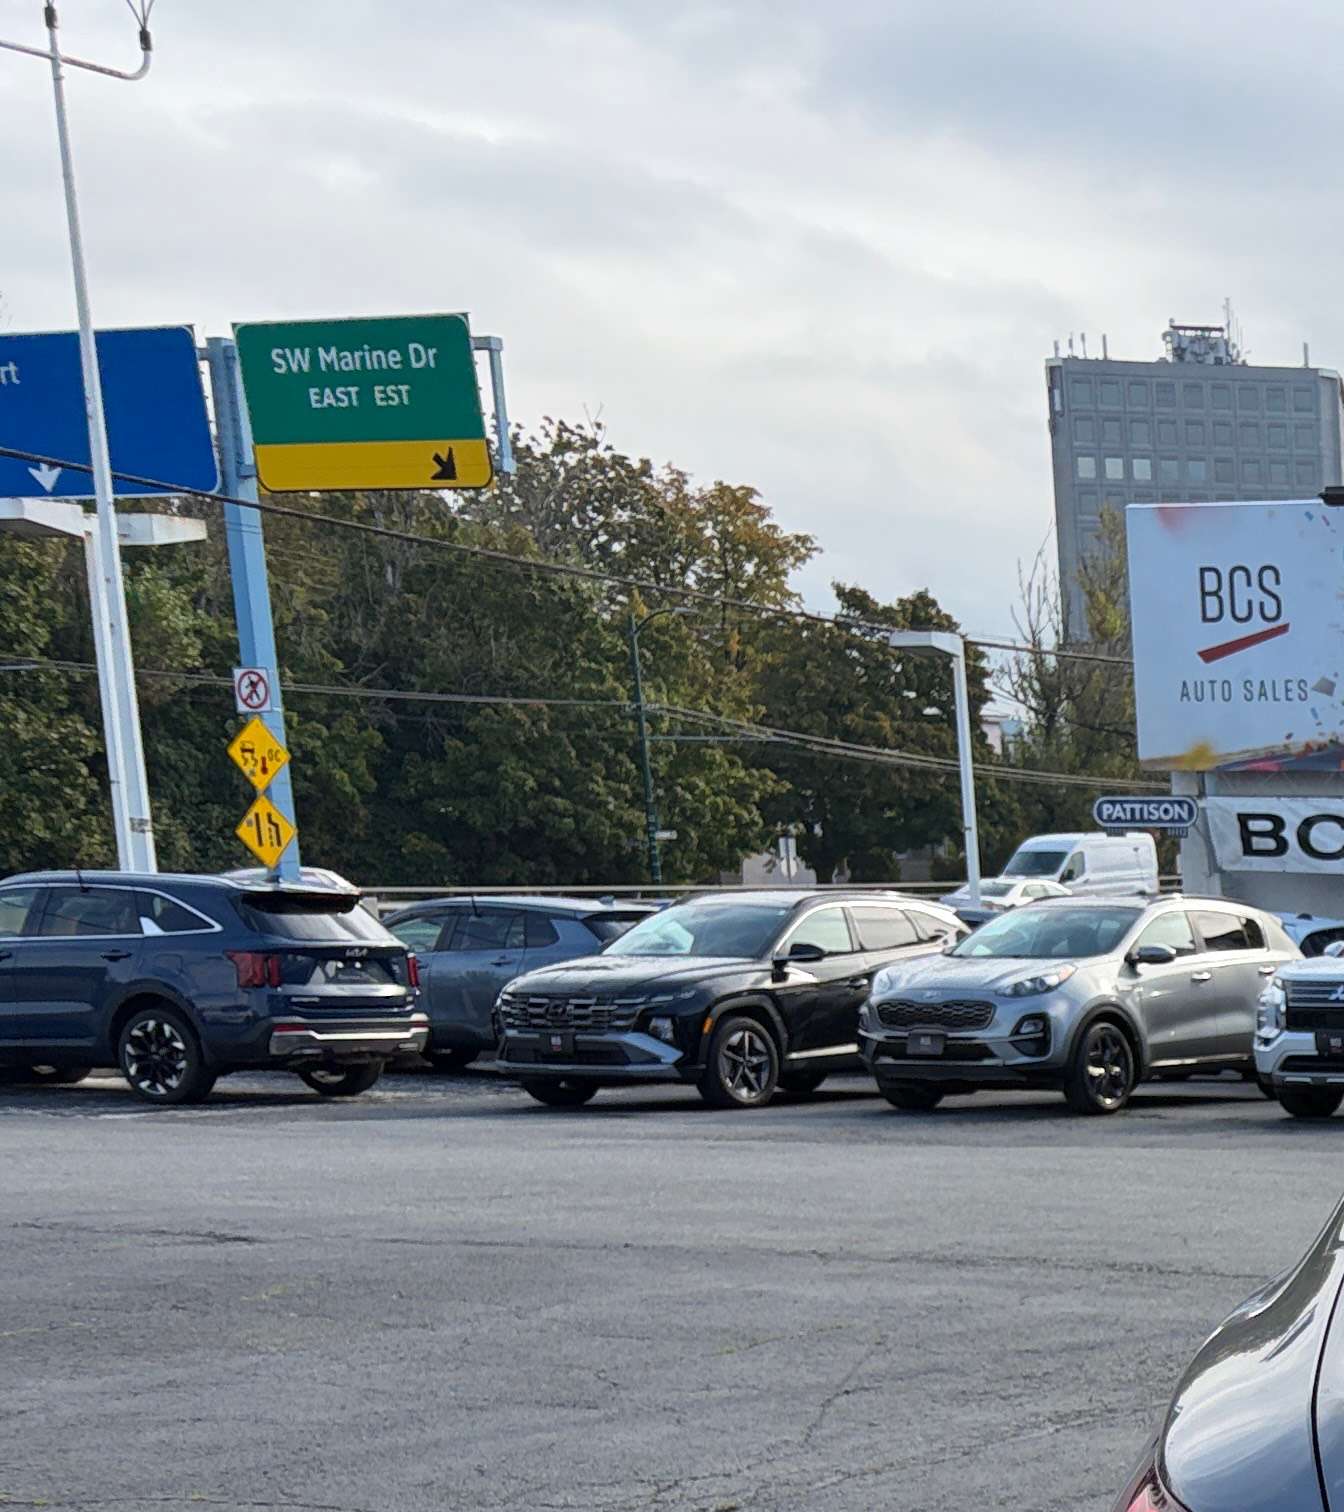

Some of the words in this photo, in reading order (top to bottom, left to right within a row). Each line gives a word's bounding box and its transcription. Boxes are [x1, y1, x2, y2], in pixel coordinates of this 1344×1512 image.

[271, 348, 311, 374] SW
[318, 344, 403, 372] Marine
[408, 343, 437, 369] Dr
[308, 386, 359, 409] EAST
[374, 384, 410, 407] EST
[1200, 565, 1283, 624] BCS
[1179, 679, 1232, 702] AUTO
[1243, 678, 1309, 702] SALES
[1102, 803, 1189, 820] PATTISON
